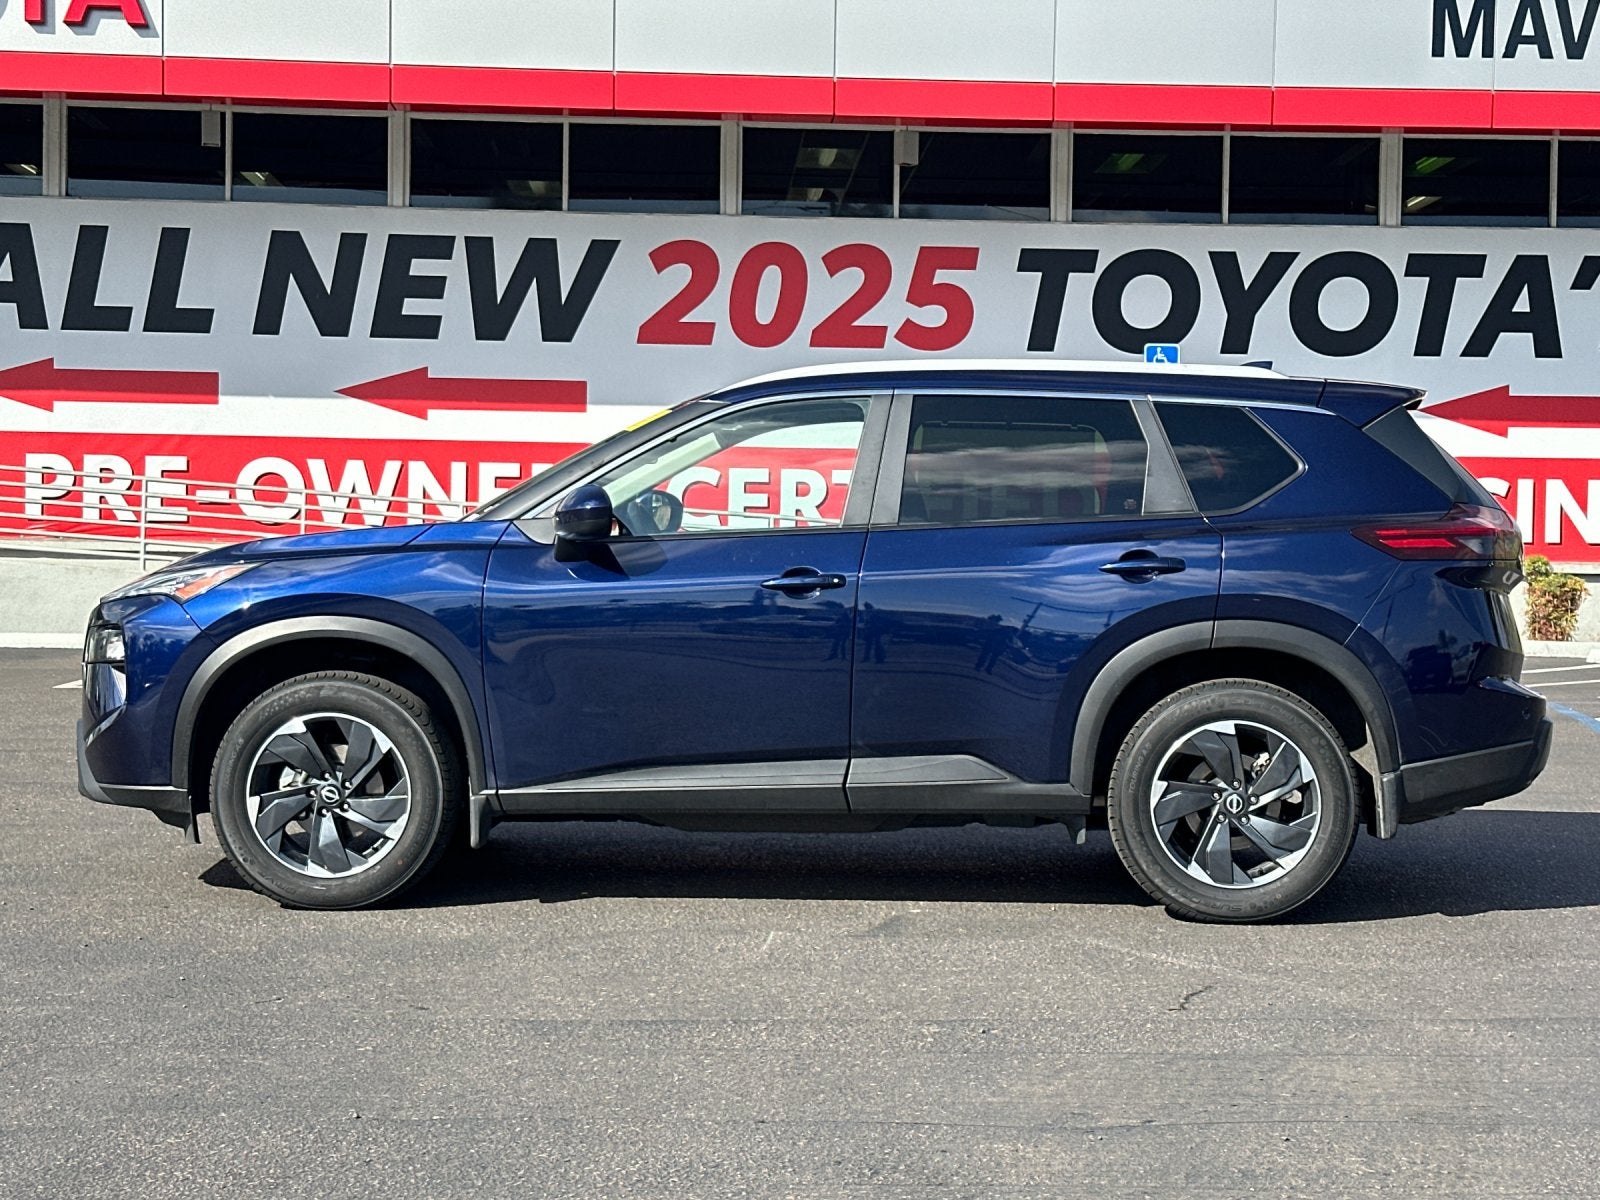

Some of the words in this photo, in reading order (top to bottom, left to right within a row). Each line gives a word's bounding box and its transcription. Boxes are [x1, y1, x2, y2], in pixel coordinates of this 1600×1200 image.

[252, 229, 621, 342] NEW
[637, 239, 981, 348] 2025
[24, 452, 555, 526] PRE-OWNE
